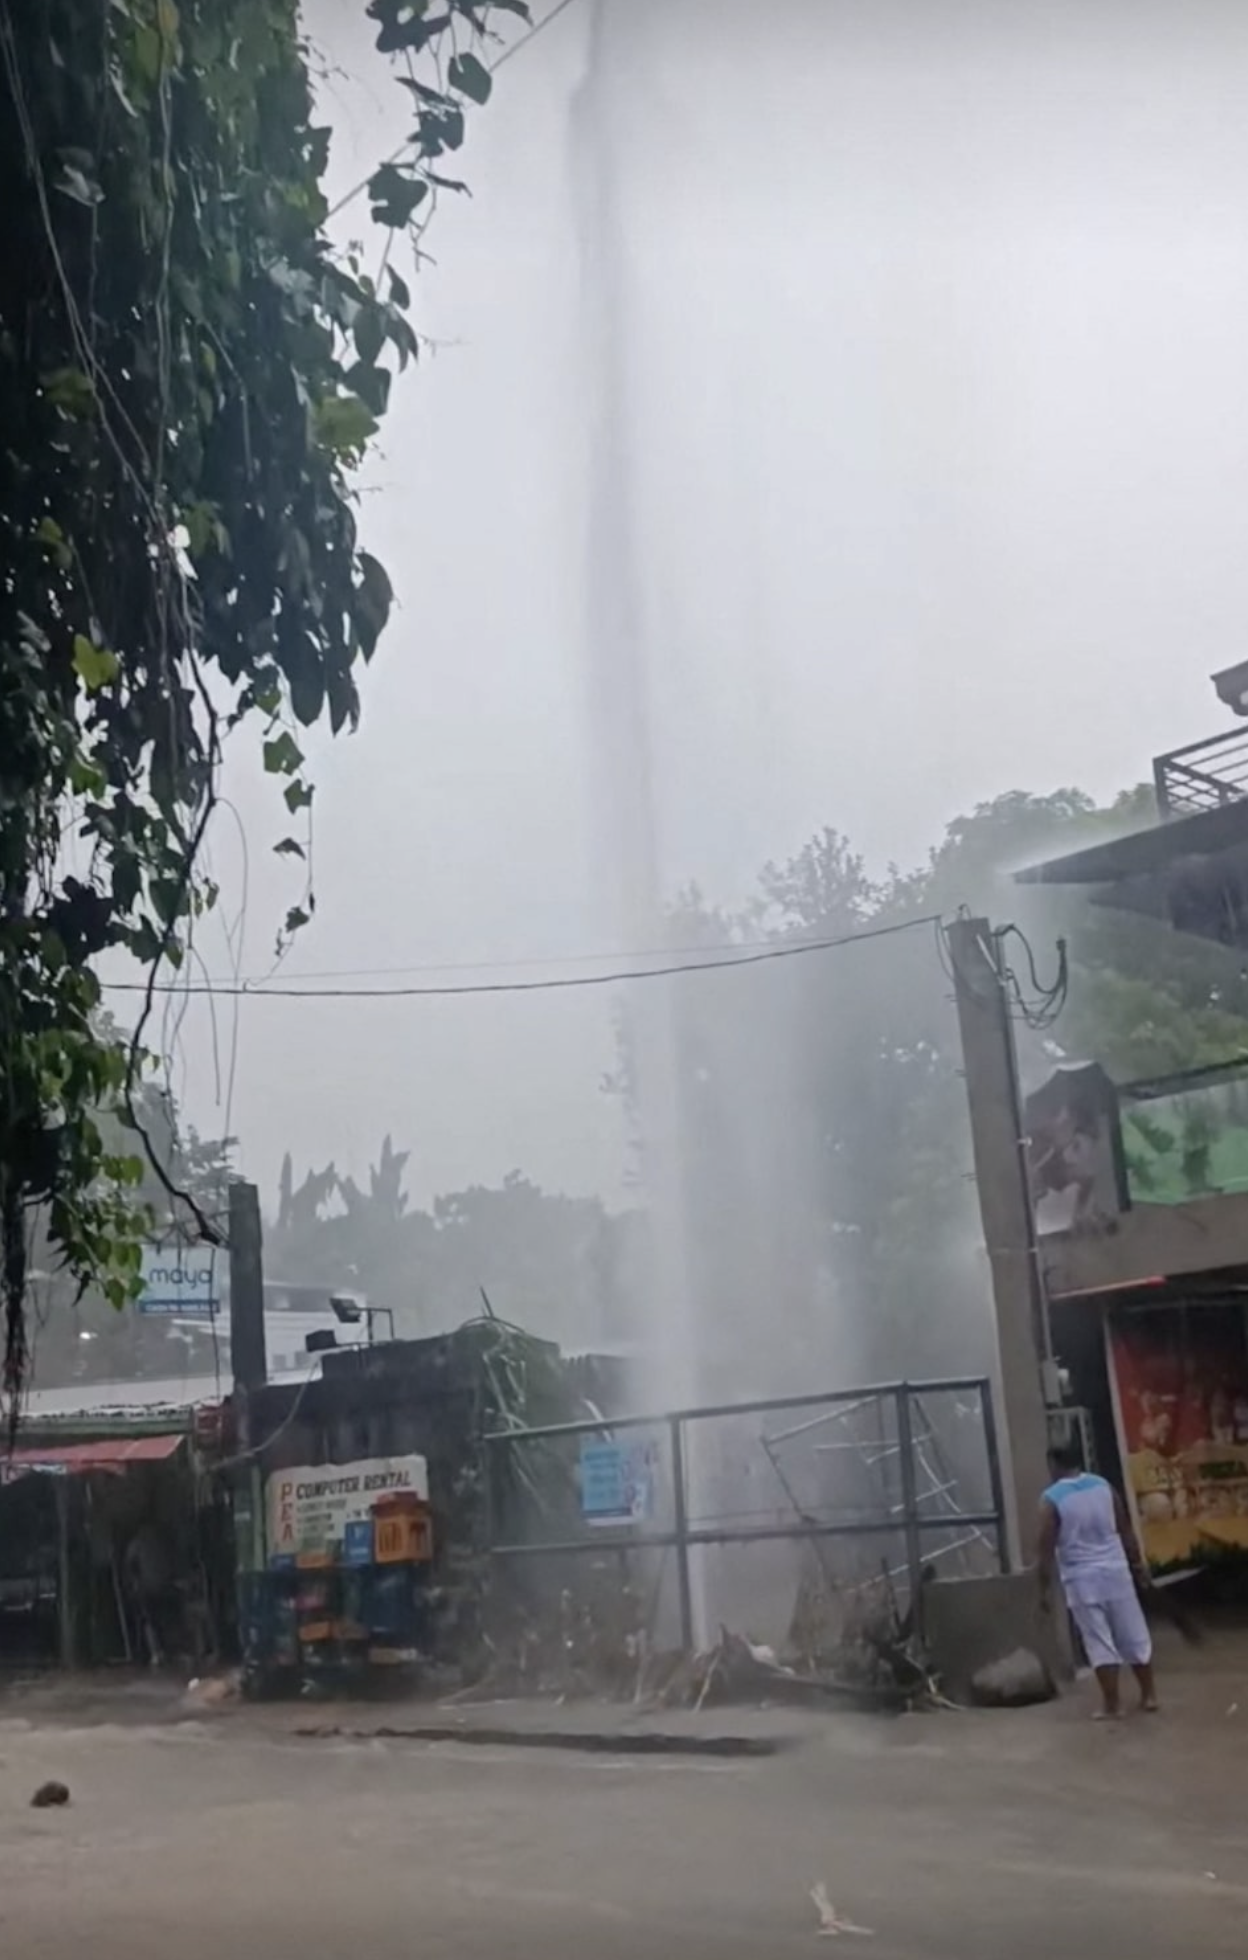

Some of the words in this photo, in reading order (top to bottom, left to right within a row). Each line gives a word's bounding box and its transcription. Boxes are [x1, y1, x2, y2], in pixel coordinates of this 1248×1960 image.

[149, 1268, 212, 1290] maya
[296, 1477, 360, 1499] COMPUTER
[364, 1470, 412, 1490] RENTAL
